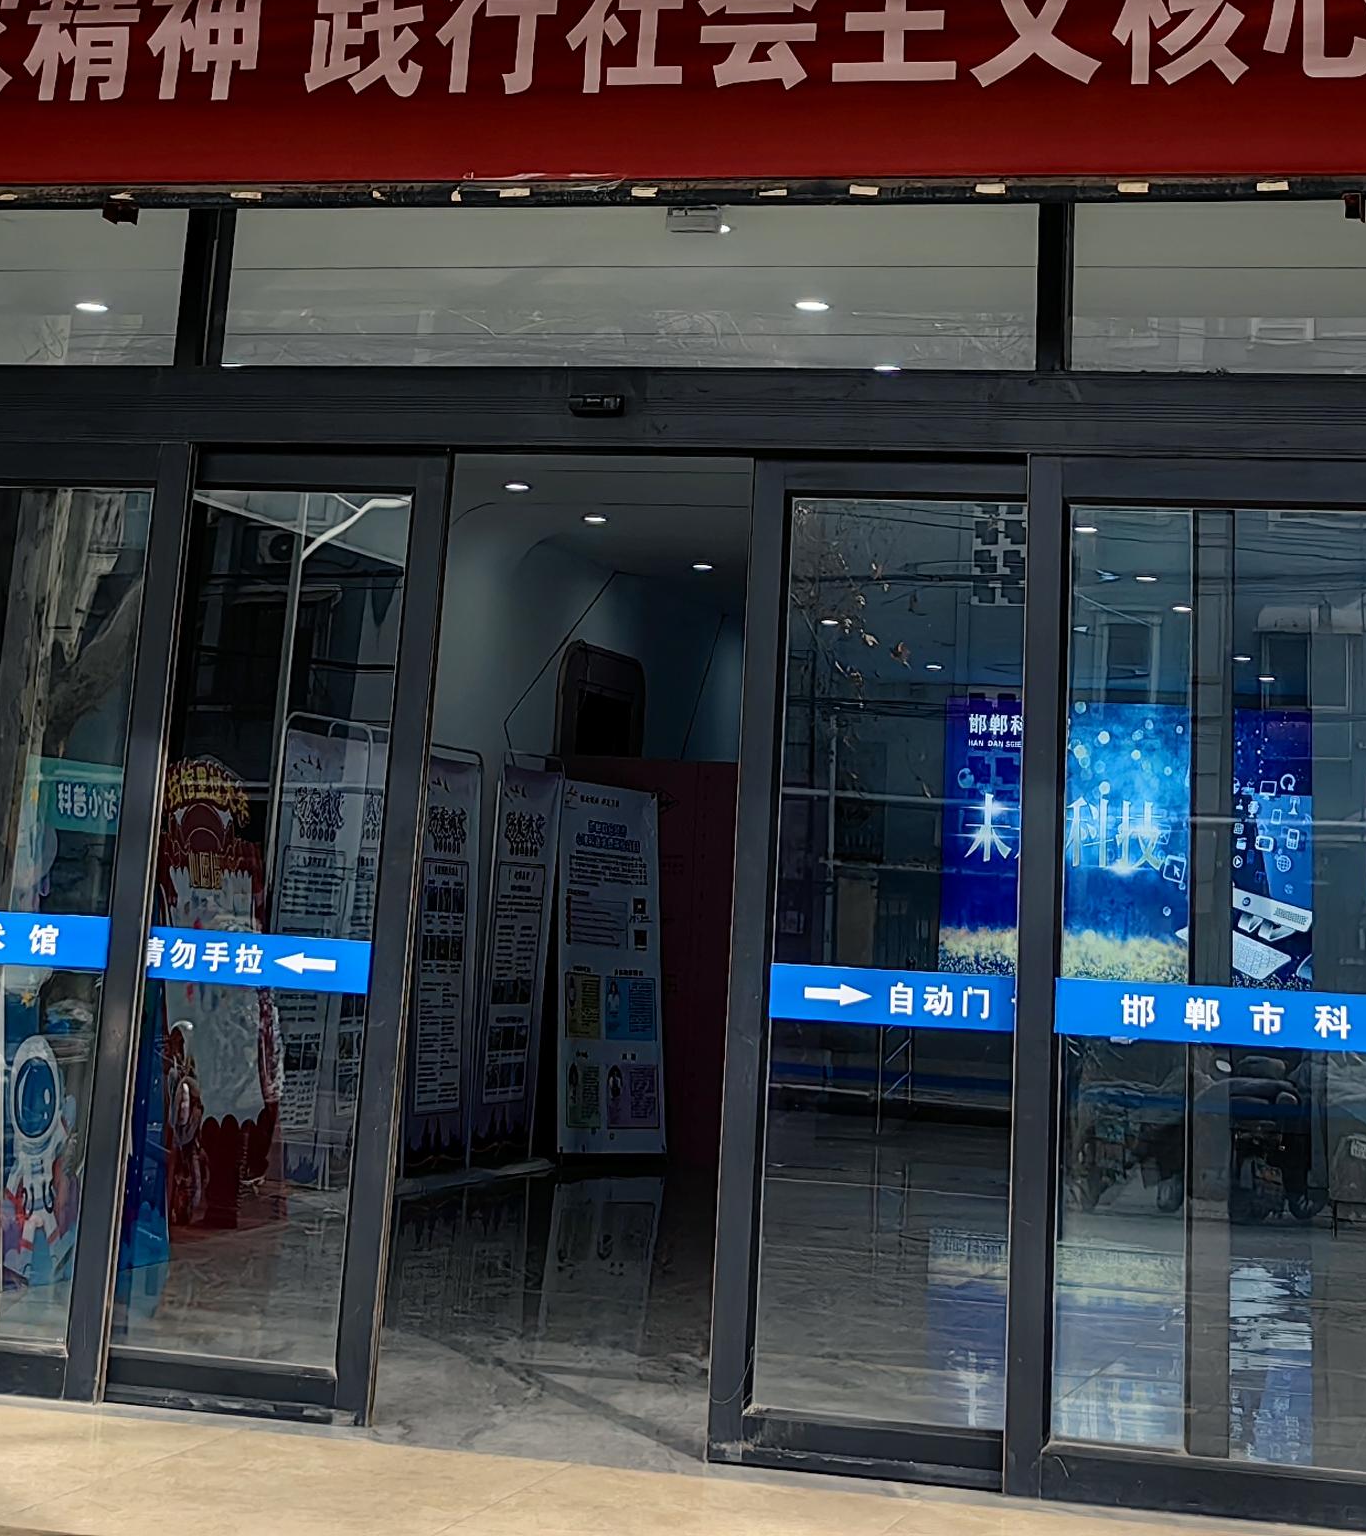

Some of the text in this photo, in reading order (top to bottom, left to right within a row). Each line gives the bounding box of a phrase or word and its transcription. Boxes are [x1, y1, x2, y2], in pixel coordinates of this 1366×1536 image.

[962, 791, 1165, 870] 未科技
[886, 979, 993, 1021] 自动门
